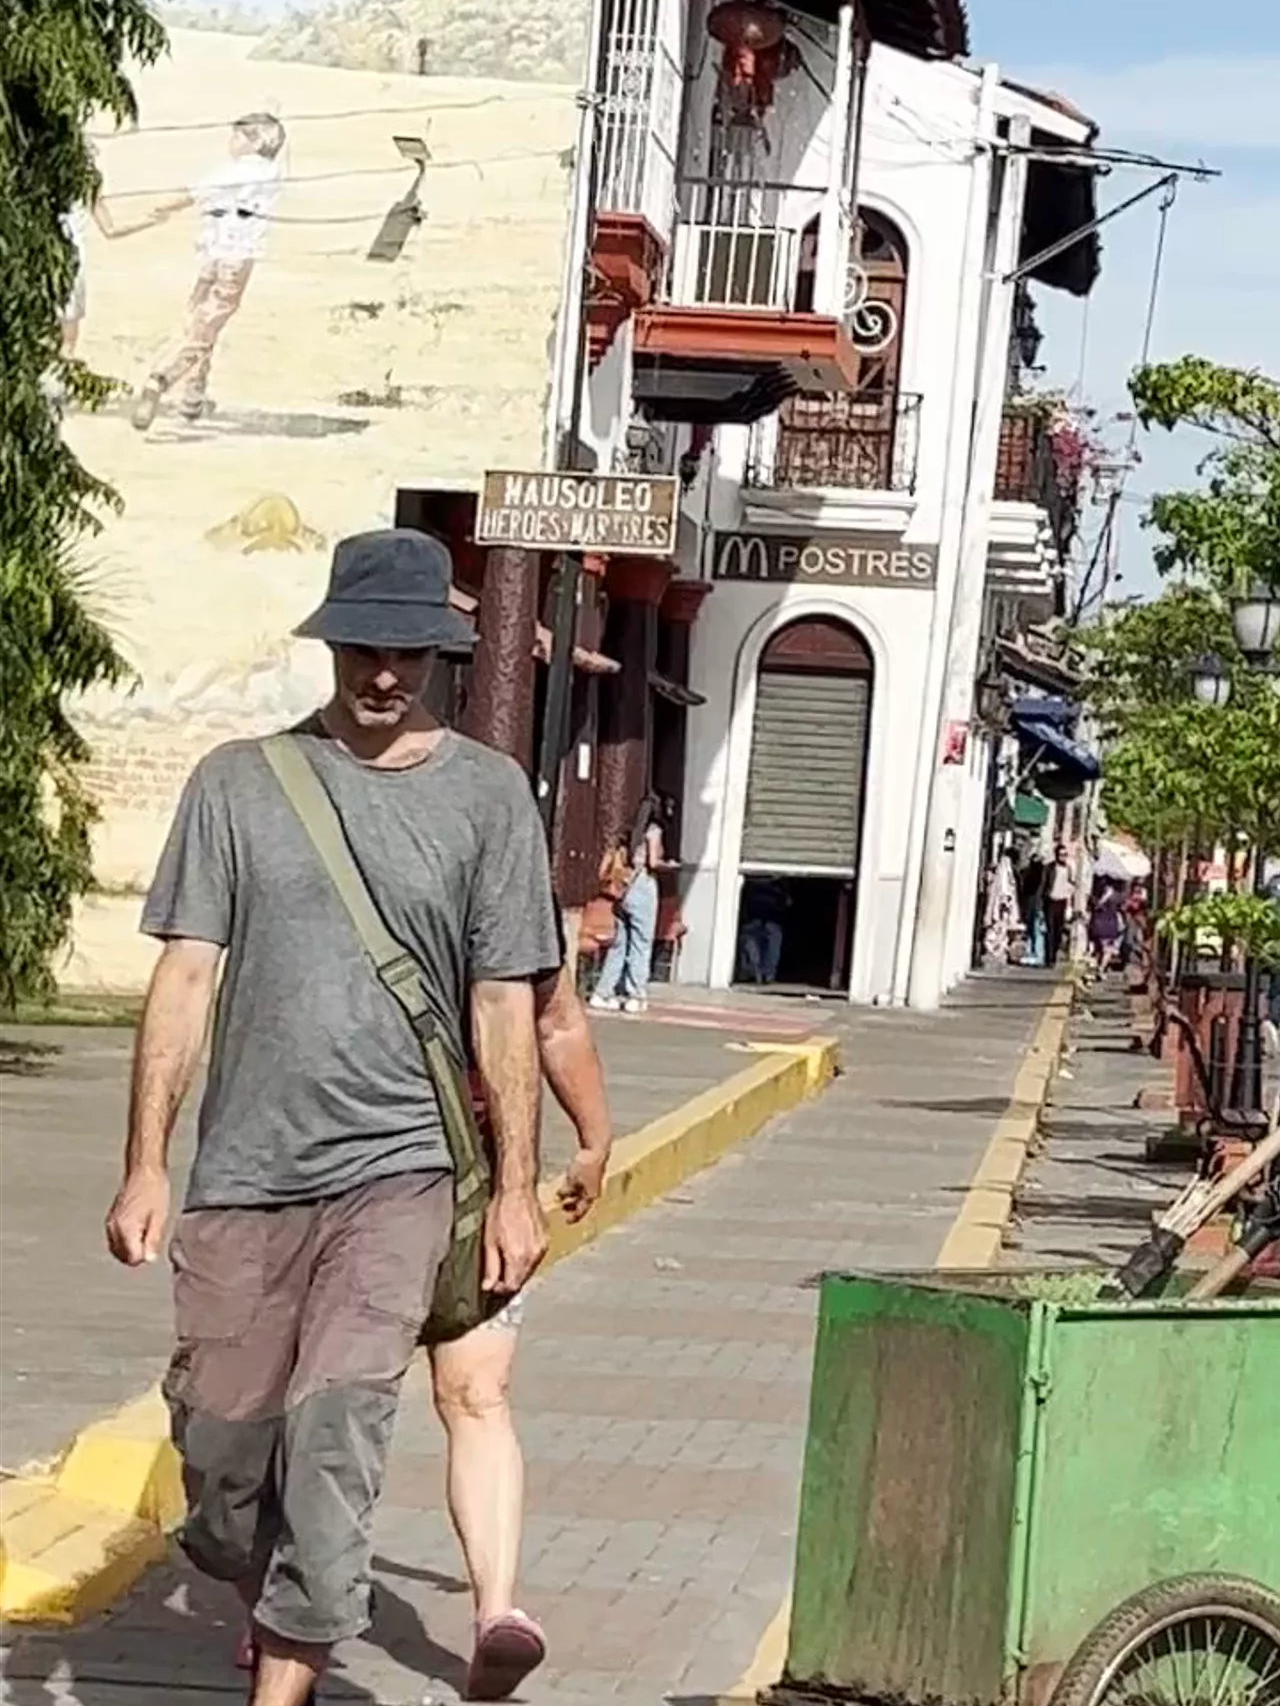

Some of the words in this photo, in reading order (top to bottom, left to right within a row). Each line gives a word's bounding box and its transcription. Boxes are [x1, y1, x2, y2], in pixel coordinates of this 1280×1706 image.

[504, 475, 652, 512] MAUSOLEO
[483, 509, 560, 541] HEROES
[718, 536, 769, 577] M
[778, 546, 932, 579] POSTRES
